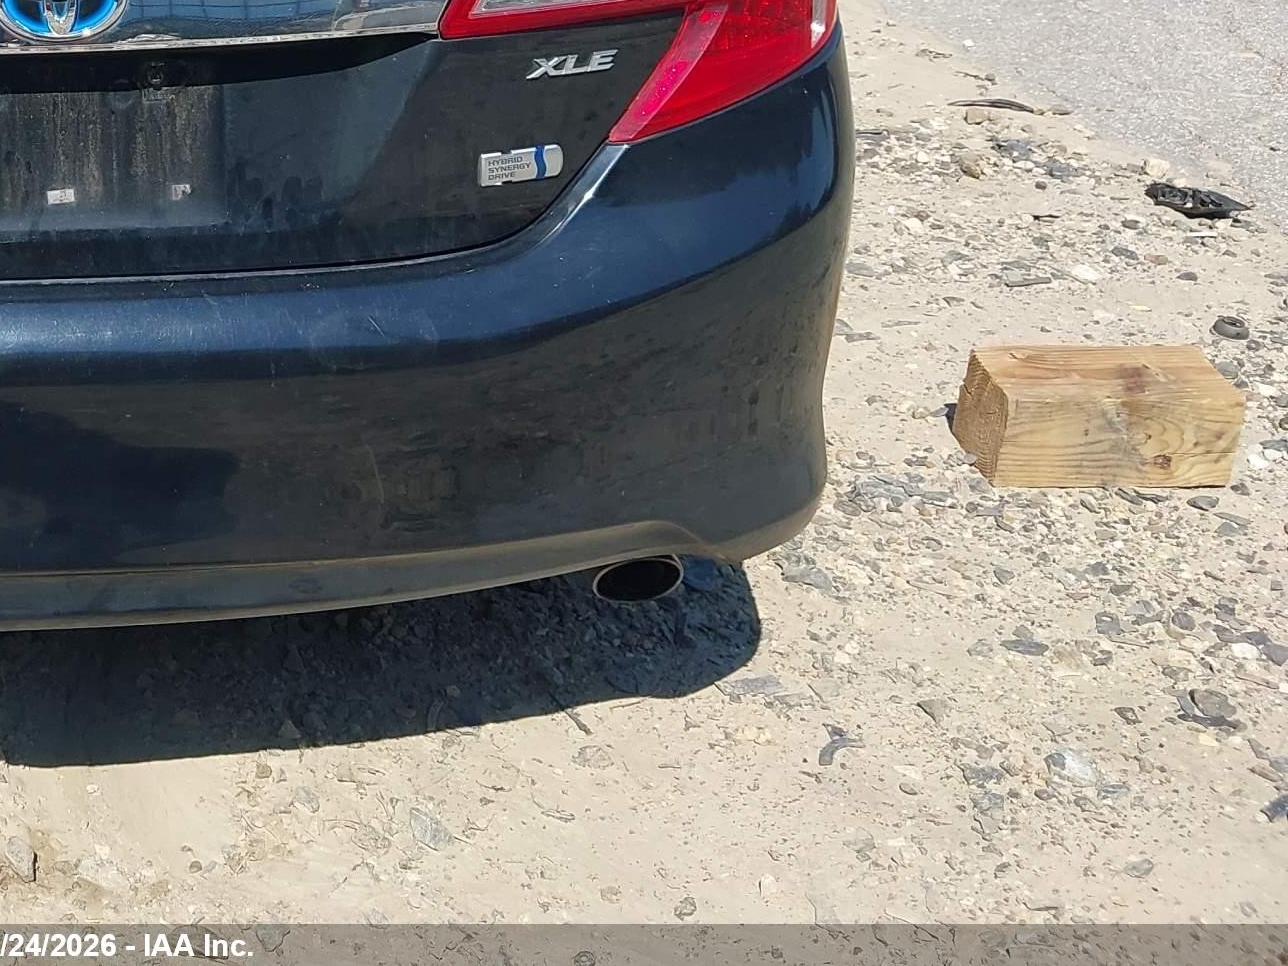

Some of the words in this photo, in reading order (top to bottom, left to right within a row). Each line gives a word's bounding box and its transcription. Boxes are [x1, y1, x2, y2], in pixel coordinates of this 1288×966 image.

[525, 49, 618, 80] XLE
[487, 156, 523, 167] HYBRID
[487, 162, 532, 174] SYNERGY
[487, 171, 517, 181] DRIVE
